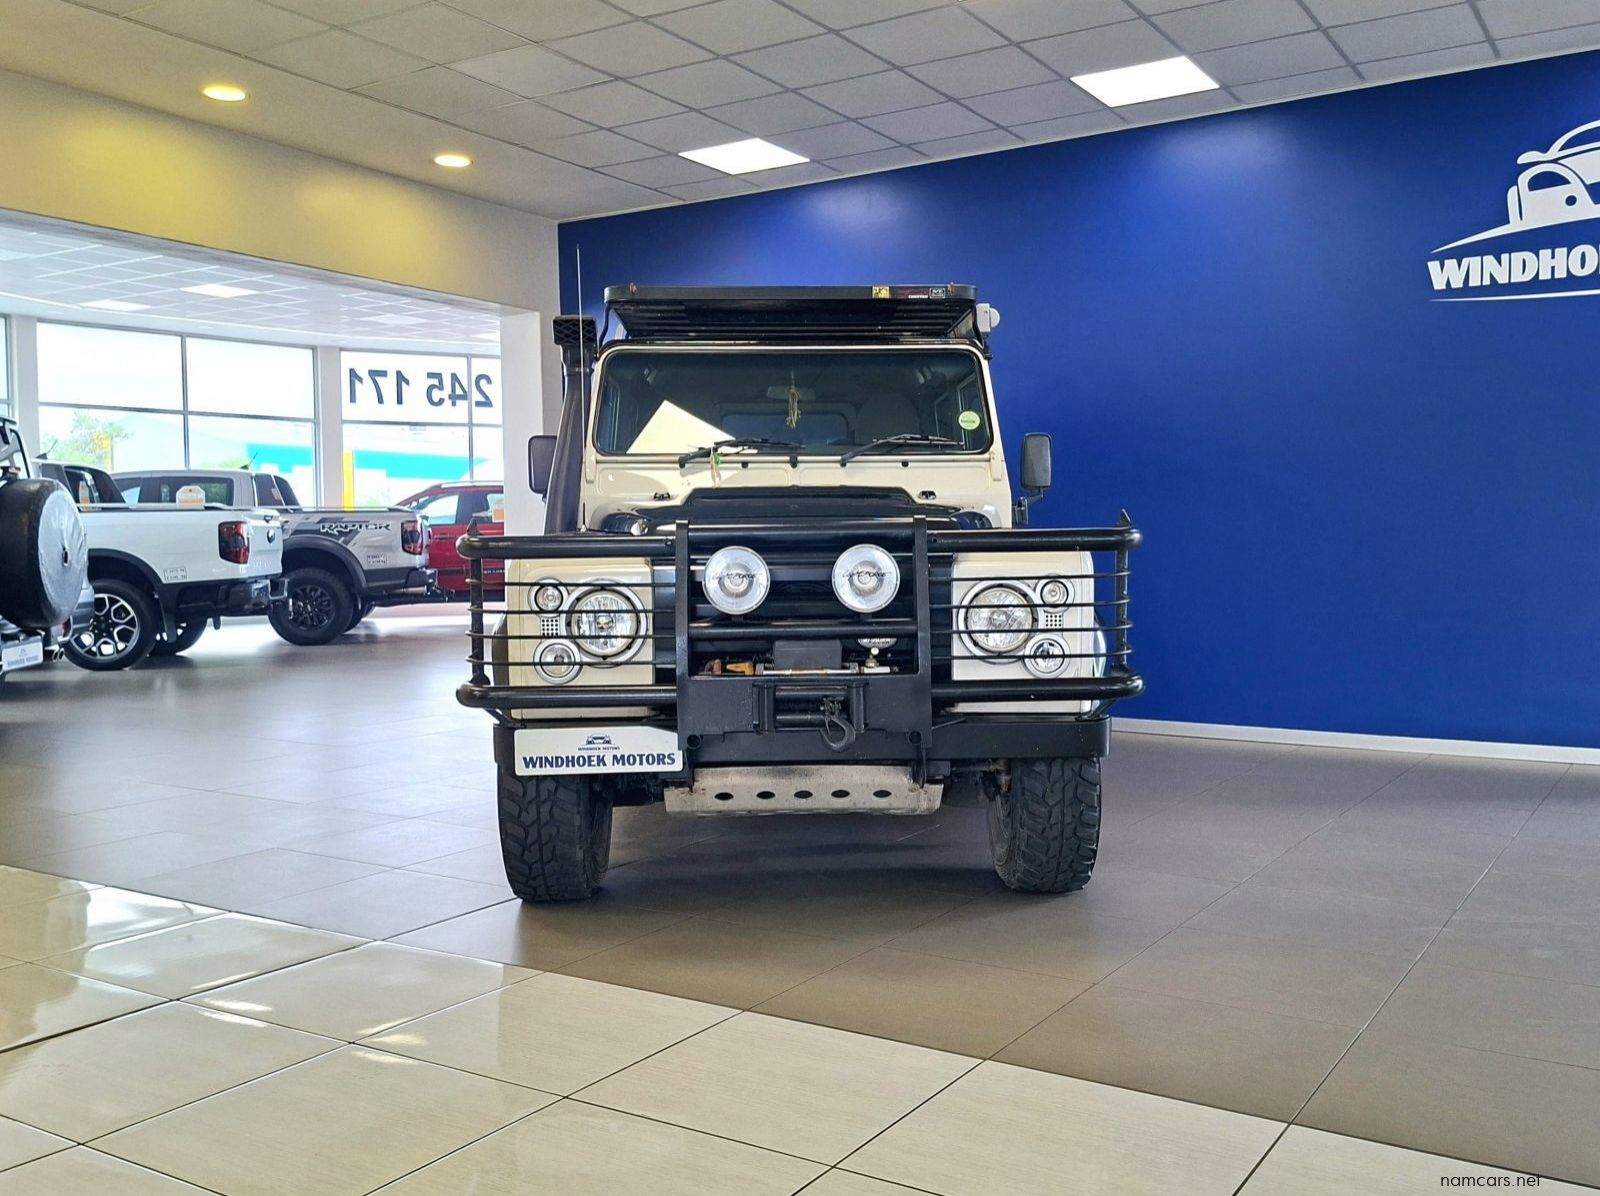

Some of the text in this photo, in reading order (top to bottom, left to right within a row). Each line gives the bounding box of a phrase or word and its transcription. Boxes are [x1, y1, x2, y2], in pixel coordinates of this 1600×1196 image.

[1427, 244, 1600, 290] WINDHO
[320, 522, 392, 536] RAPTOR
[522, 752, 676, 769] WINDHOEK MOTORS
